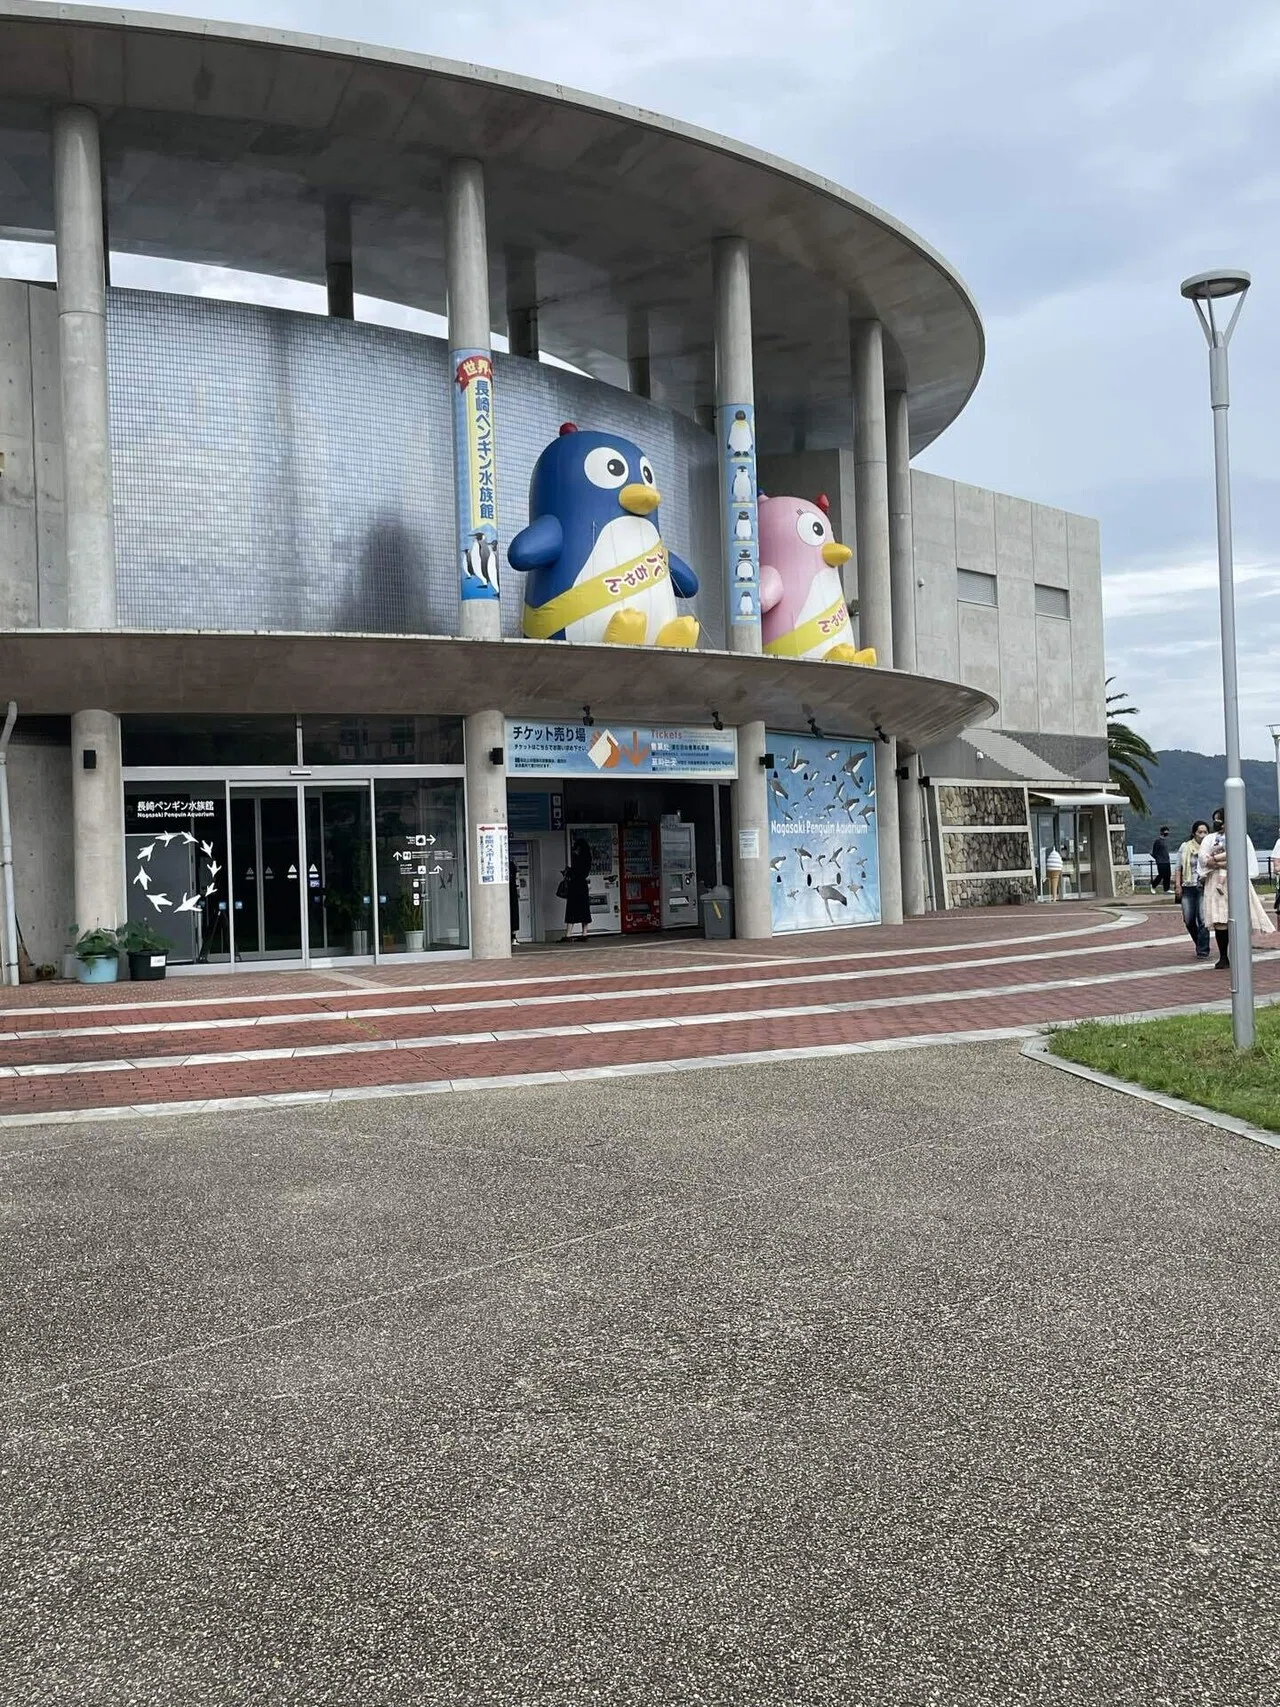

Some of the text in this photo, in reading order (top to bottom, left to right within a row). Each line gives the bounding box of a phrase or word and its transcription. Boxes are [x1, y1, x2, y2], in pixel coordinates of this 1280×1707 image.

[475, 379, 494, 520] 長崎ペンギン水族館
[513, 725, 586, 743] チケット売り場
[651, 729, 683, 740] Tickets
[137, 801, 215, 812] 長崎ペンギン水族館
[770, 820, 868, 837] Nagasaki Penguin Aquarium
